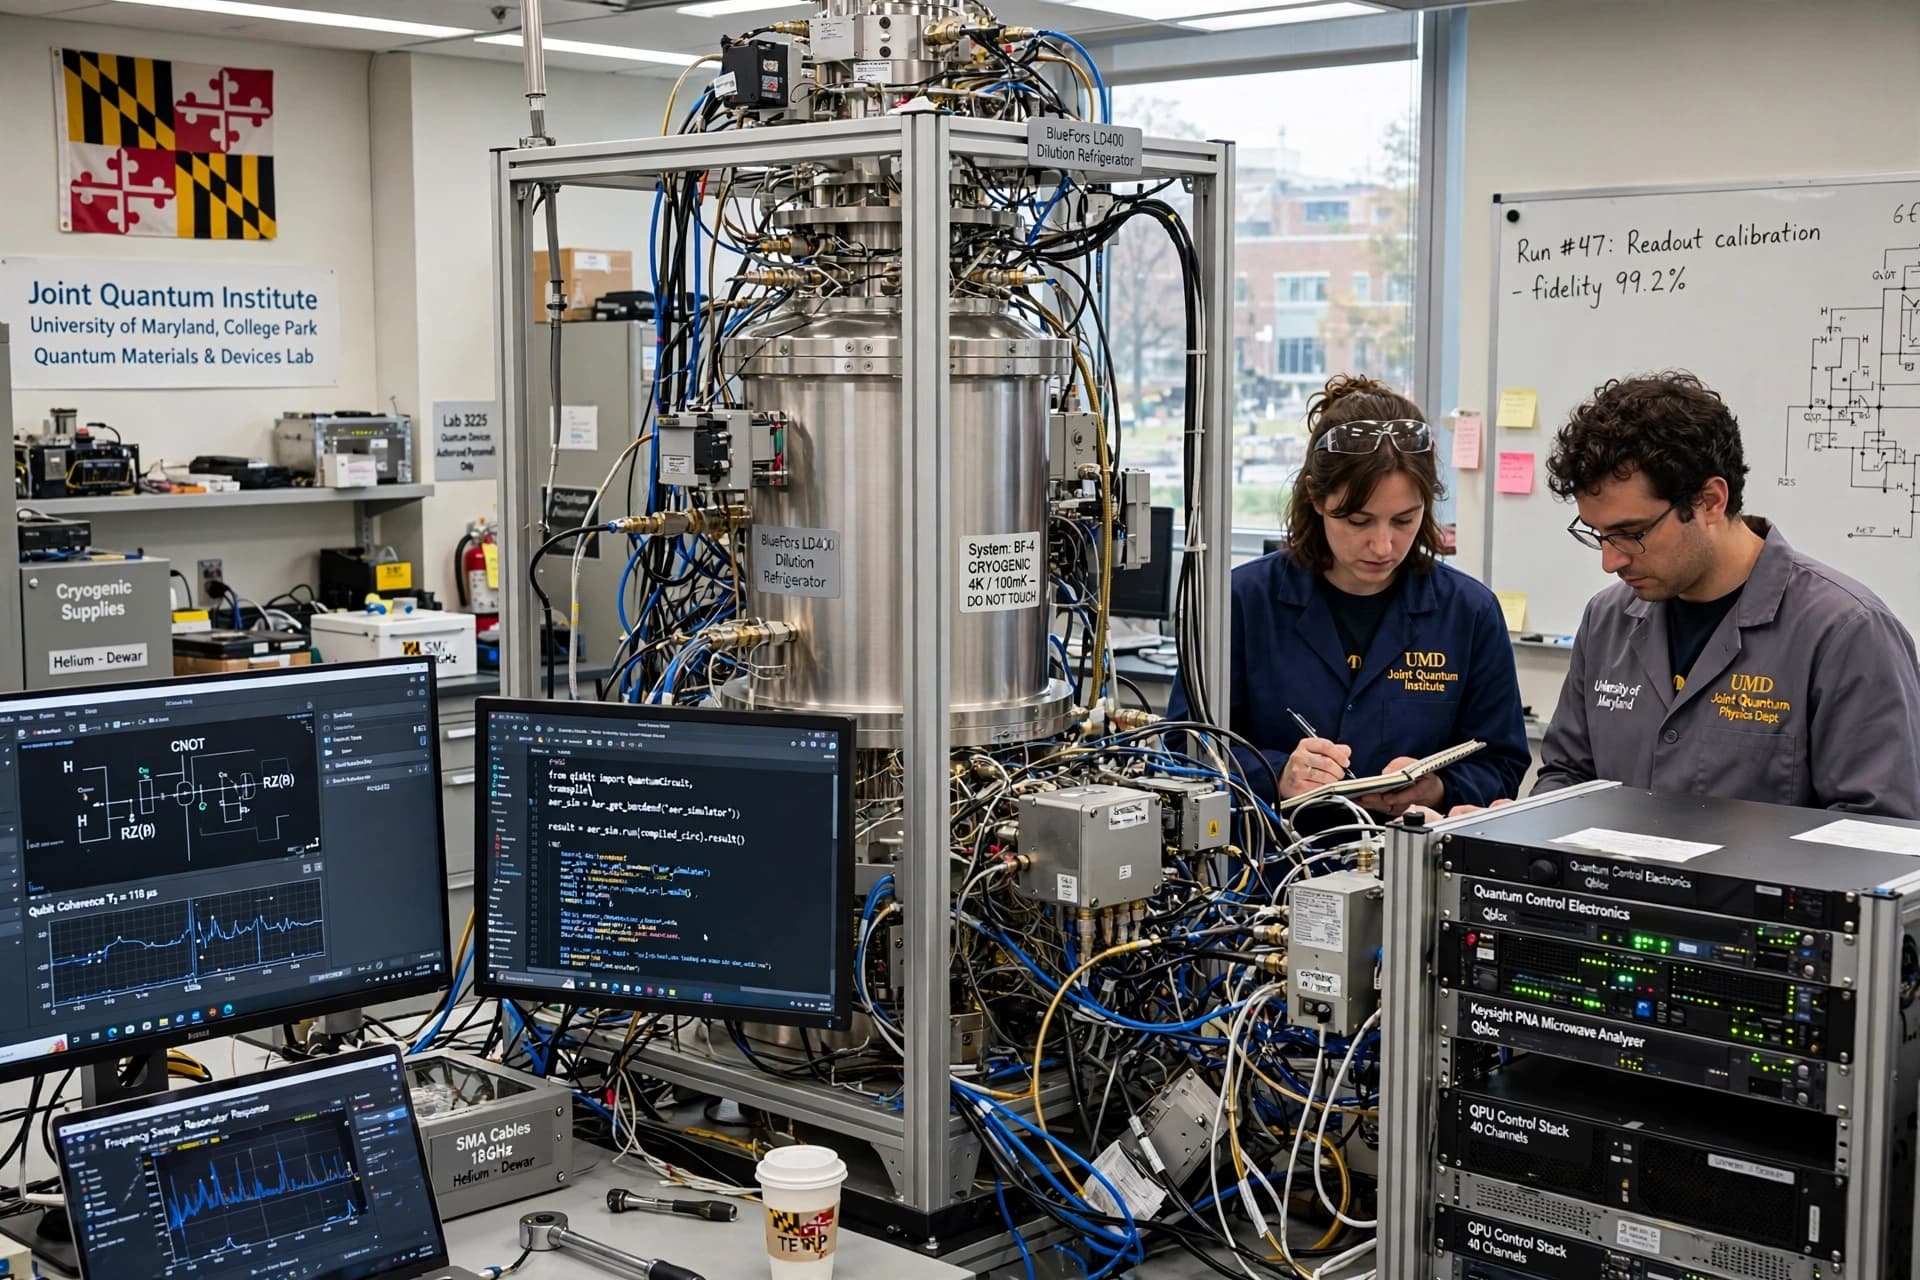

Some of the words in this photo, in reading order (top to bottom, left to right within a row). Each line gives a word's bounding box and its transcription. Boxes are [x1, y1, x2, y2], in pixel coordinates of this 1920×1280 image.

[1046, 126, 1090, 145] BlueFors
[1093, 130, 1124, 148] LD400
[1036, 143, 1075, 161] Dilution
[1078, 148, 1134, 168] Refrigerator
[1517, 238, 1551, 264] Run
[1560, 234, 1614, 257] #47:
[1628, 228, 1704, 255] Readout
[1714, 222, 1822, 249] calibration
[28, 280, 93, 306] Joint
[99, 282, 215, 311] Quantum
[222, 285, 319, 311] Institute
[1531, 274, 1603, 310] fidelity
[1615, 265, 1687, 295] 99.2%
[29, 315, 116, 338] University
[119, 316, 138, 335] of
[141, 317, 221, 339] Maryland,
[223, 318, 281, 340] College
[284, 319, 319, 337] Park
[34, 346, 117, 367] Quantum
[121, 347, 200, 365] Materials
[204, 348, 217, 365] &
[220, 347, 283, 365] Devices
[286, 347, 316, 365] Lab
[442, 414, 461, 428] Lab
[463, 413, 489, 428] 3225
[761, 533, 800, 550] BlueFors
[968, 542, 1012, 559] System:
[1014, 540, 1035, 554] BF-4
[775, 552, 815, 569] Dilution
[968, 558, 1031, 574] CRYOGENIC
[764, 569, 826, 589] Refrigerator
[968, 577, 984, 591] 4K
[994, 574, 1028, 589] 100mK
[56, 579, 132, 602] Cryogenic
[967, 594, 984, 607] DO
[986, 593, 1007, 606] NOT
[1008, 589, 1037, 605] TOUCH
[61, 600, 126, 622] Supplies
[53, 655, 94, 670] Helium
[106, 650, 143, 667] Dewar
[1405, 652, 1446, 668] UMD
[1387, 669, 1414, 680] Joint
[1416, 669, 1458, 681] Quantum
[1730, 673, 1774, 693] UMD
[1405, 680, 1445, 692] Institute
[1711, 692, 1737, 705] Joint
[1739, 694, 1790, 711] Quantum
[1755, 711, 1780, 723] Dept
[171, 737, 205, 752] CNOT
[63, 761, 73, 773] H
[600, 773, 625, 785] import
[77, 814, 88, 827] H
[548, 822, 575, 832] result
[1611, 865, 1644, 881] Control
[28, 903, 55, 918] Qubit
[57, 896, 105, 912] Coherence
[1473, 884, 1523, 904] Quantum
[1525, 892, 1566, 910] Control
[1568, 899, 1631, 922] Electronics
[1470, 1002, 1513, 1023] Keysight
[1515, 1011, 1539, 1028] PNA
[1541, 1016, 1597, 1039] Microwave
[1598, 1027, 1646, 1049] Analyzer
[1469, 1104, 1495, 1121] QPU
[1497, 1110, 1536, 1130] Control
[1538, 1119, 1570, 1139] Stack
[456, 1131, 487, 1151] SMA
[489, 1122, 531, 1142] Cables
[1470, 1121, 1483, 1134] 40
[1484, 1123, 1529, 1145] Channels
[471, 1142, 513, 1165] 18GHz
[453, 1169, 489, 1187] Helium
[501, 1156, 536, 1174] Dewar
[1467, 1221, 1492, 1238] QPU
[1494, 1228, 1534, 1249] Control
[1536, 1239, 1567, 1259] Stack
[1467, 1238, 1480, 1251] 40
[1482, 1241, 1527, 1264] Channels
